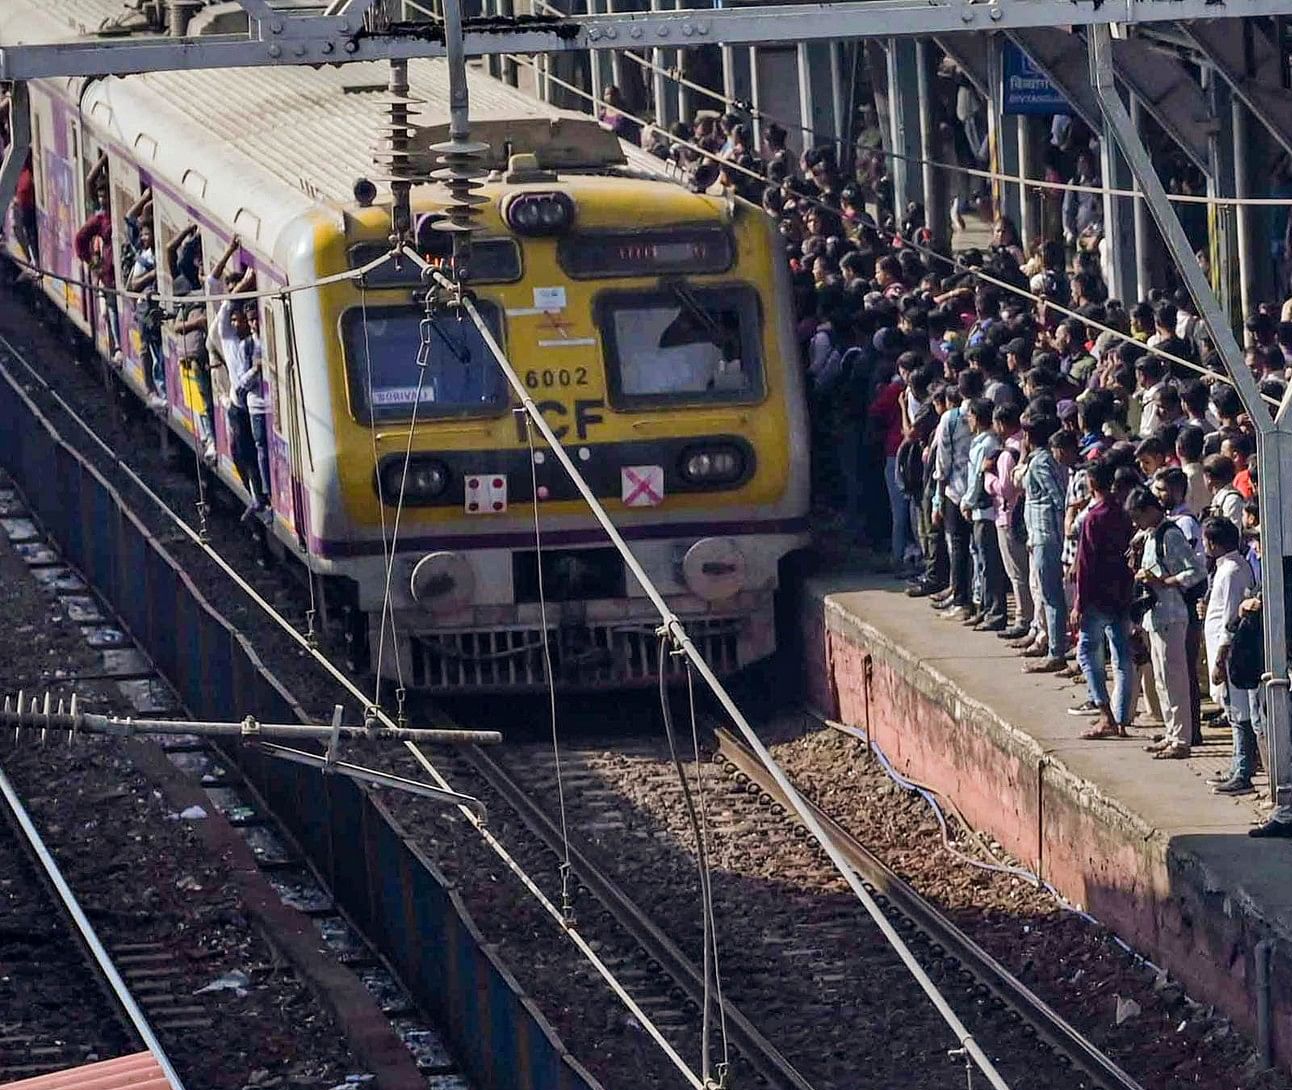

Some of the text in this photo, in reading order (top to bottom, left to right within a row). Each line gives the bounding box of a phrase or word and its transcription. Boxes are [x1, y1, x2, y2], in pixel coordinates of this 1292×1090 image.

[525, 367, 588, 388] 6002
[377, 390, 428, 401] BORIVAI
[515, 400, 604, 442] ICF
